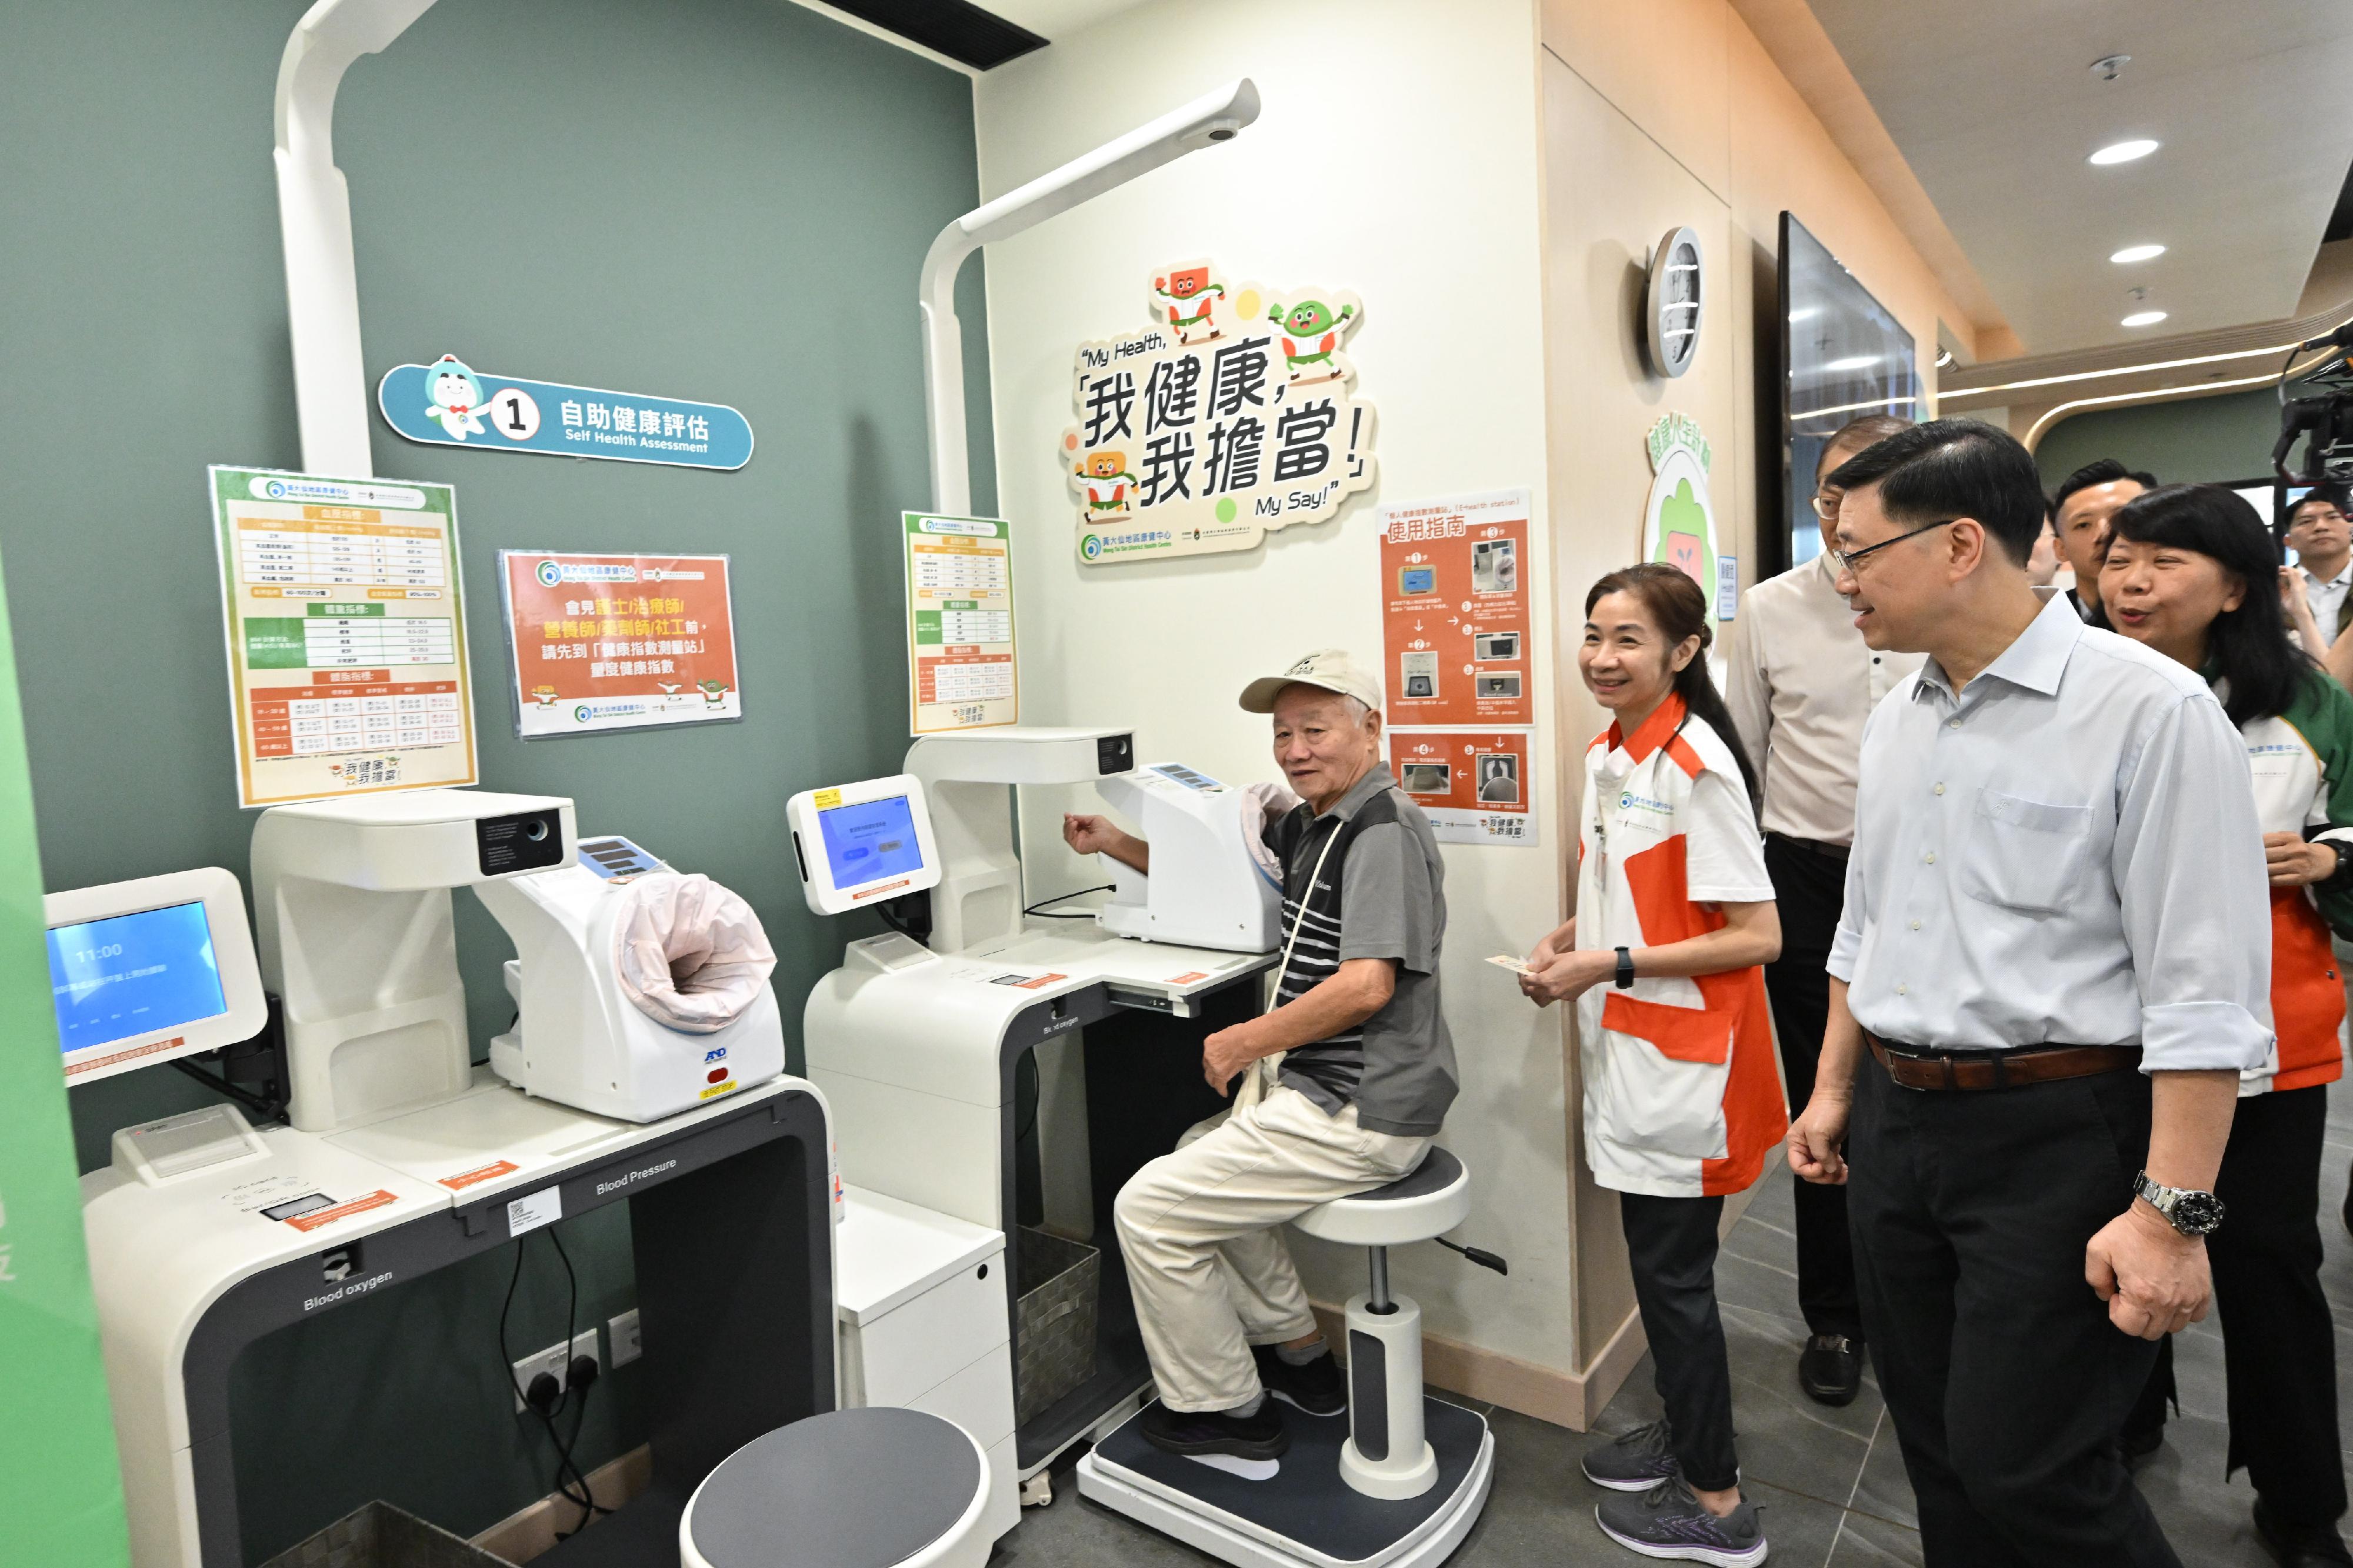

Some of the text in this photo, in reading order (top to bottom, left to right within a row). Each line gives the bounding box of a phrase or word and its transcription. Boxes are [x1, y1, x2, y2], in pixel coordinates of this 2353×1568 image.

[1115, 333, 1166, 360] Health,
[506, 398, 526, 431] 1
[561, 399, 709, 441] 自助健康評估
[565, 429, 708, 453] Self Health Assessment
[1255, 497, 1281, 516] My
[1387, 514, 1465, 542] 使用指南
[565, 598, 684, 616] 會見護士/治療師/
[591, 659, 675, 678] 量度健康指數
[76, 943, 122, 963] 11:00
[596, 1157, 676, 1196] Blood Pressure
[304, 1271, 392, 1311] Blood oxygen
